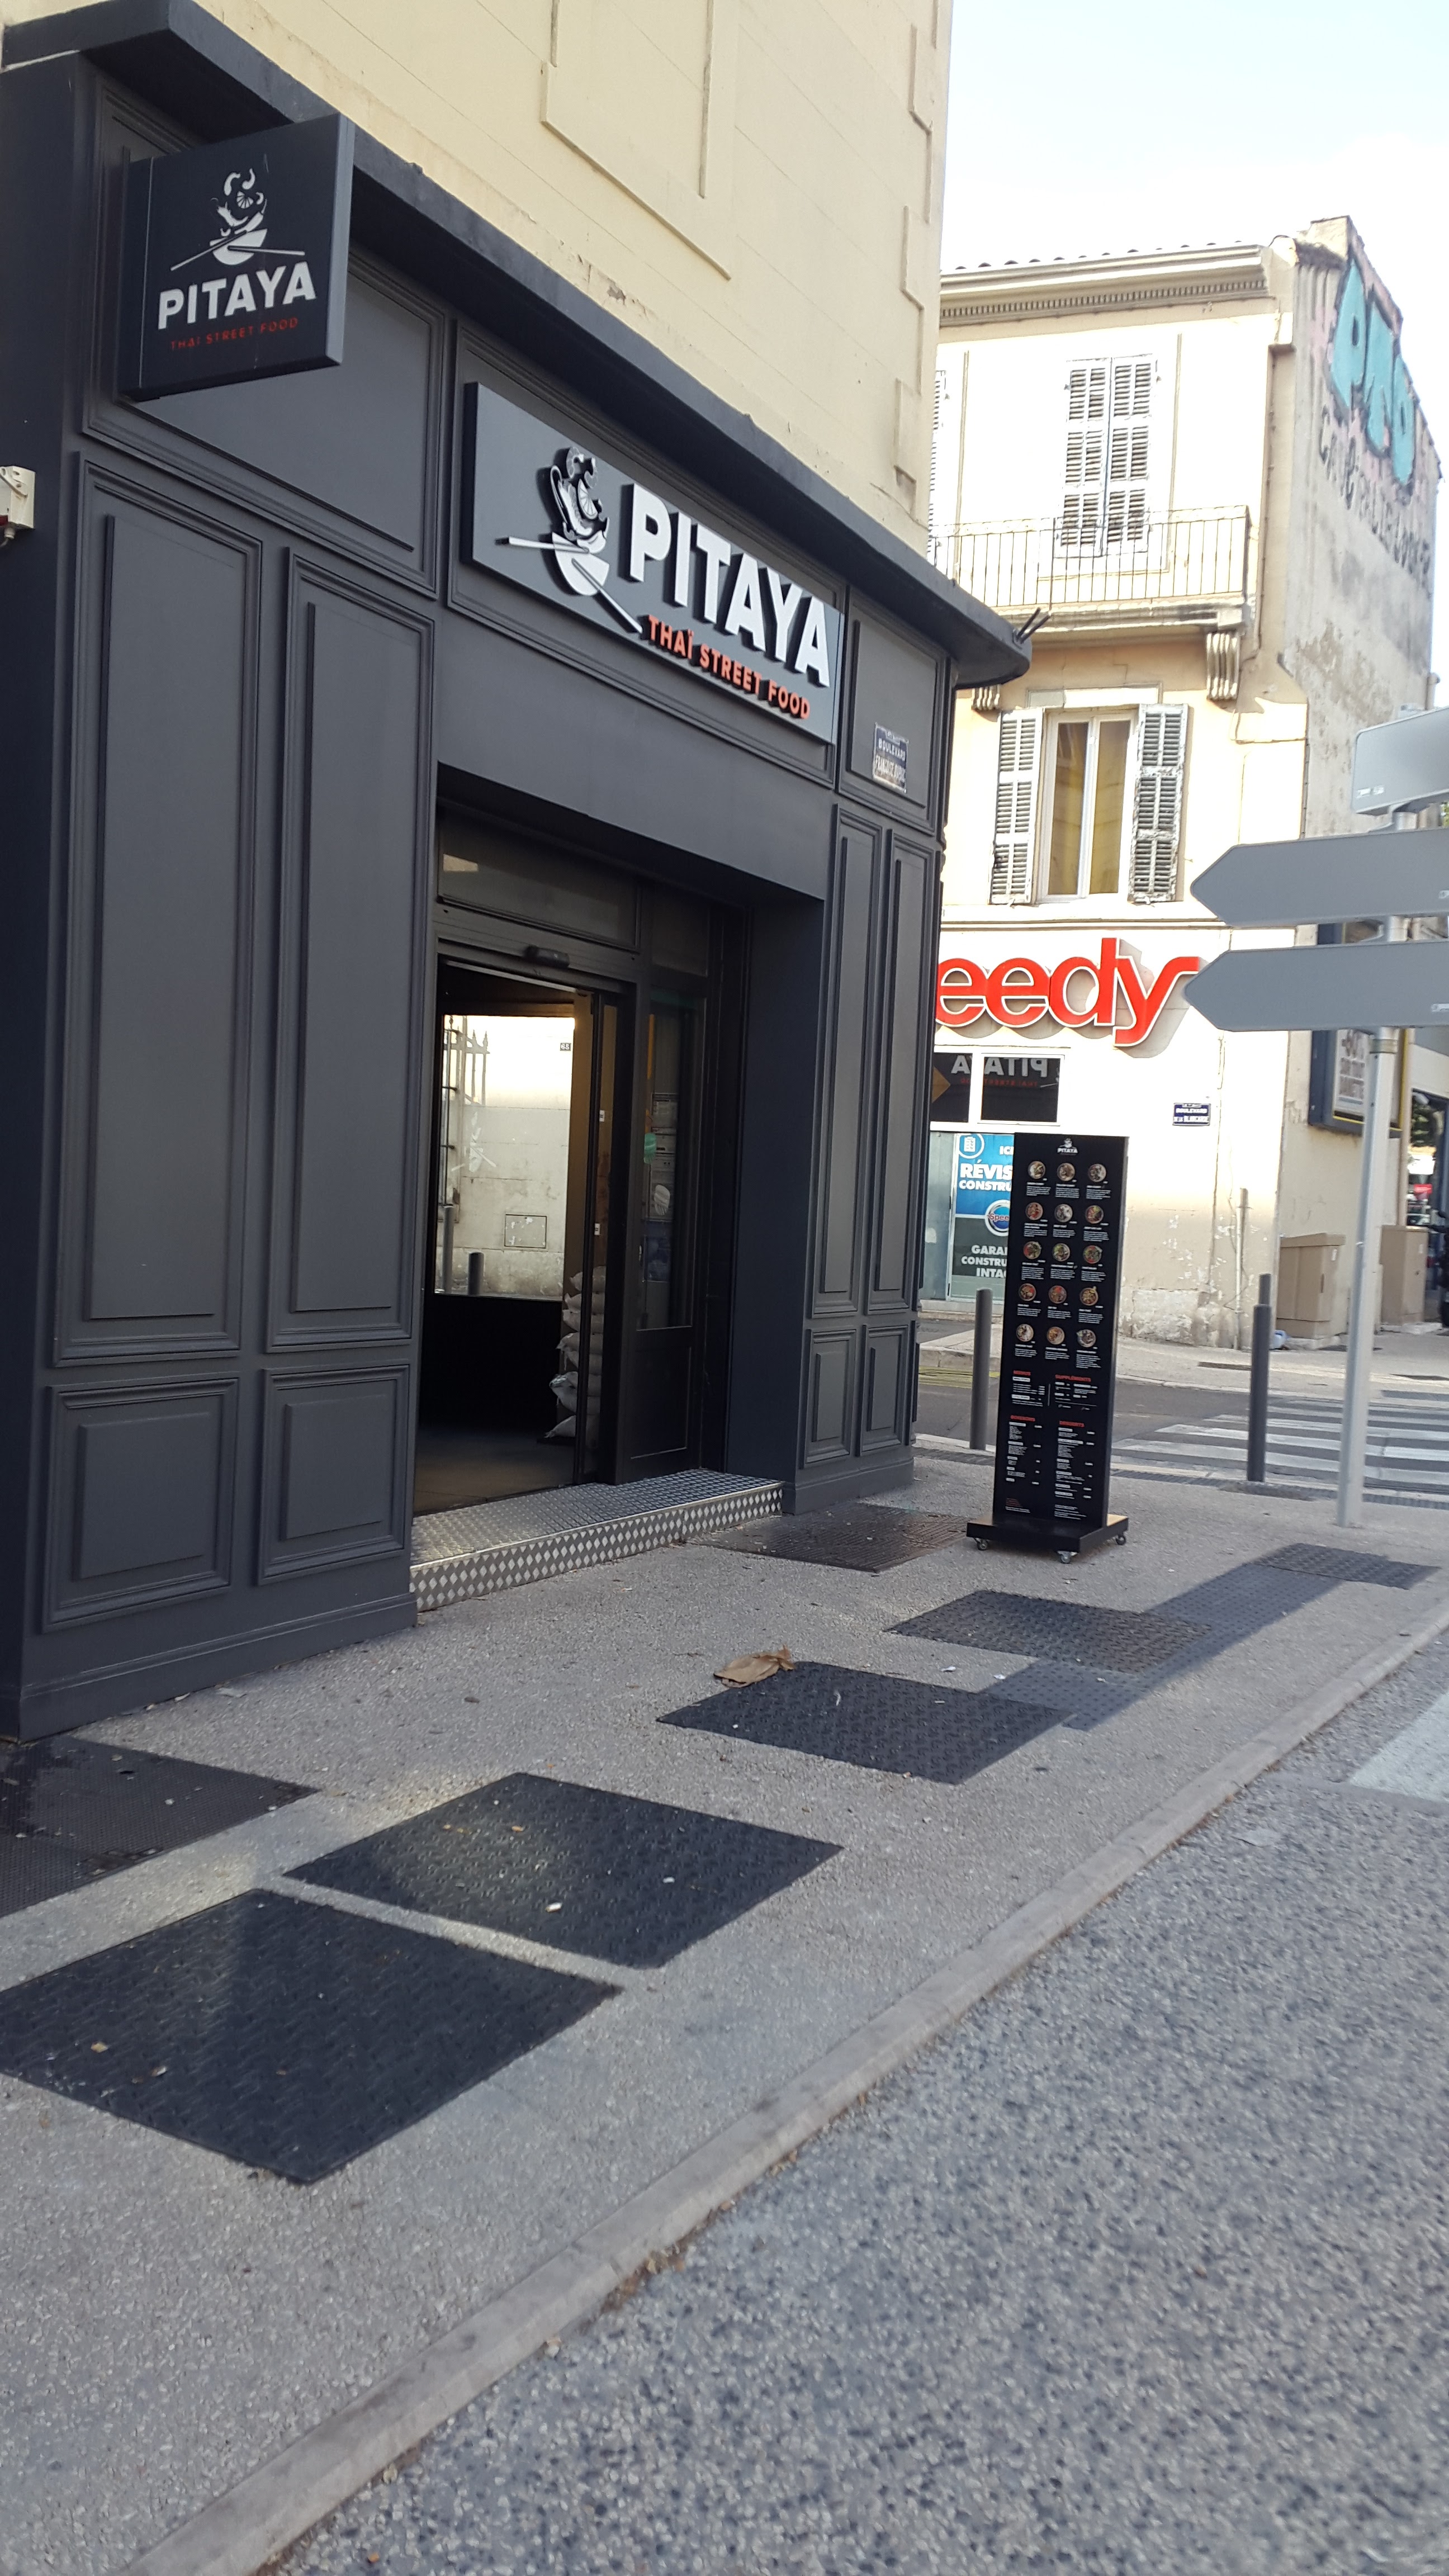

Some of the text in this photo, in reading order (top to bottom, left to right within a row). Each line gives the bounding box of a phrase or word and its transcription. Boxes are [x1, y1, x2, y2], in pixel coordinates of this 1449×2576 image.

[158, 261, 316, 330] PITAYA
[206, 326, 254, 344] STREET
[260, 317, 299, 333] FOOD
[630, 482, 830, 688] PITAYA
[647, 614, 811, 719] THAÏ STREET FOOD
[878, 737, 906, 761] BOULEVARD
